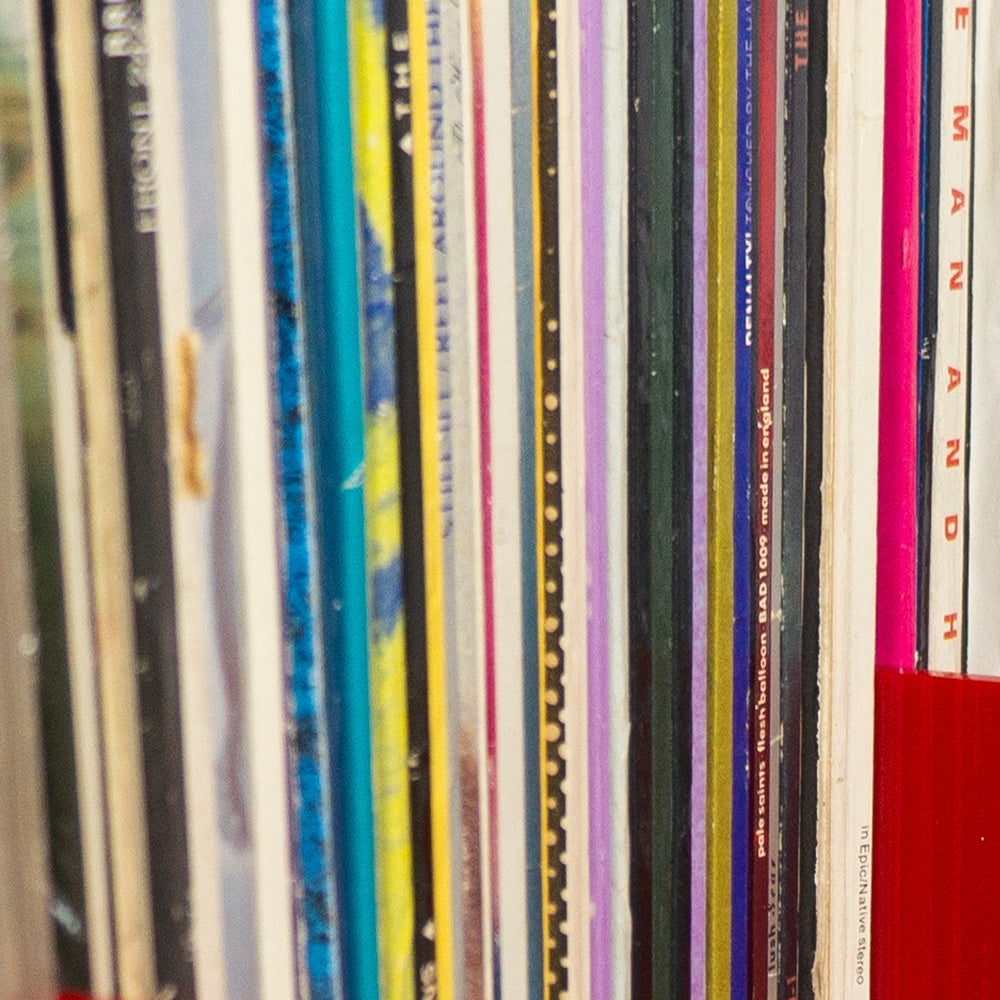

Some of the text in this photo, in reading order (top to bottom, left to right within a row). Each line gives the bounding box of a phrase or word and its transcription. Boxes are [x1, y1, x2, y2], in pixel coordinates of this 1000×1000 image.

[391, 29, 411, 121] THE
[793, 10, 810, 71] THE
[428, 82, 446, 254] AROUND
[949, 104, 970, 292] MAN
[944, 365, 962, 542] AND
[755, 368, 774, 858] pale saints flesh balloon BAD 1009 made in england
[856, 824, 871, 985] in Epic/Native stereo
